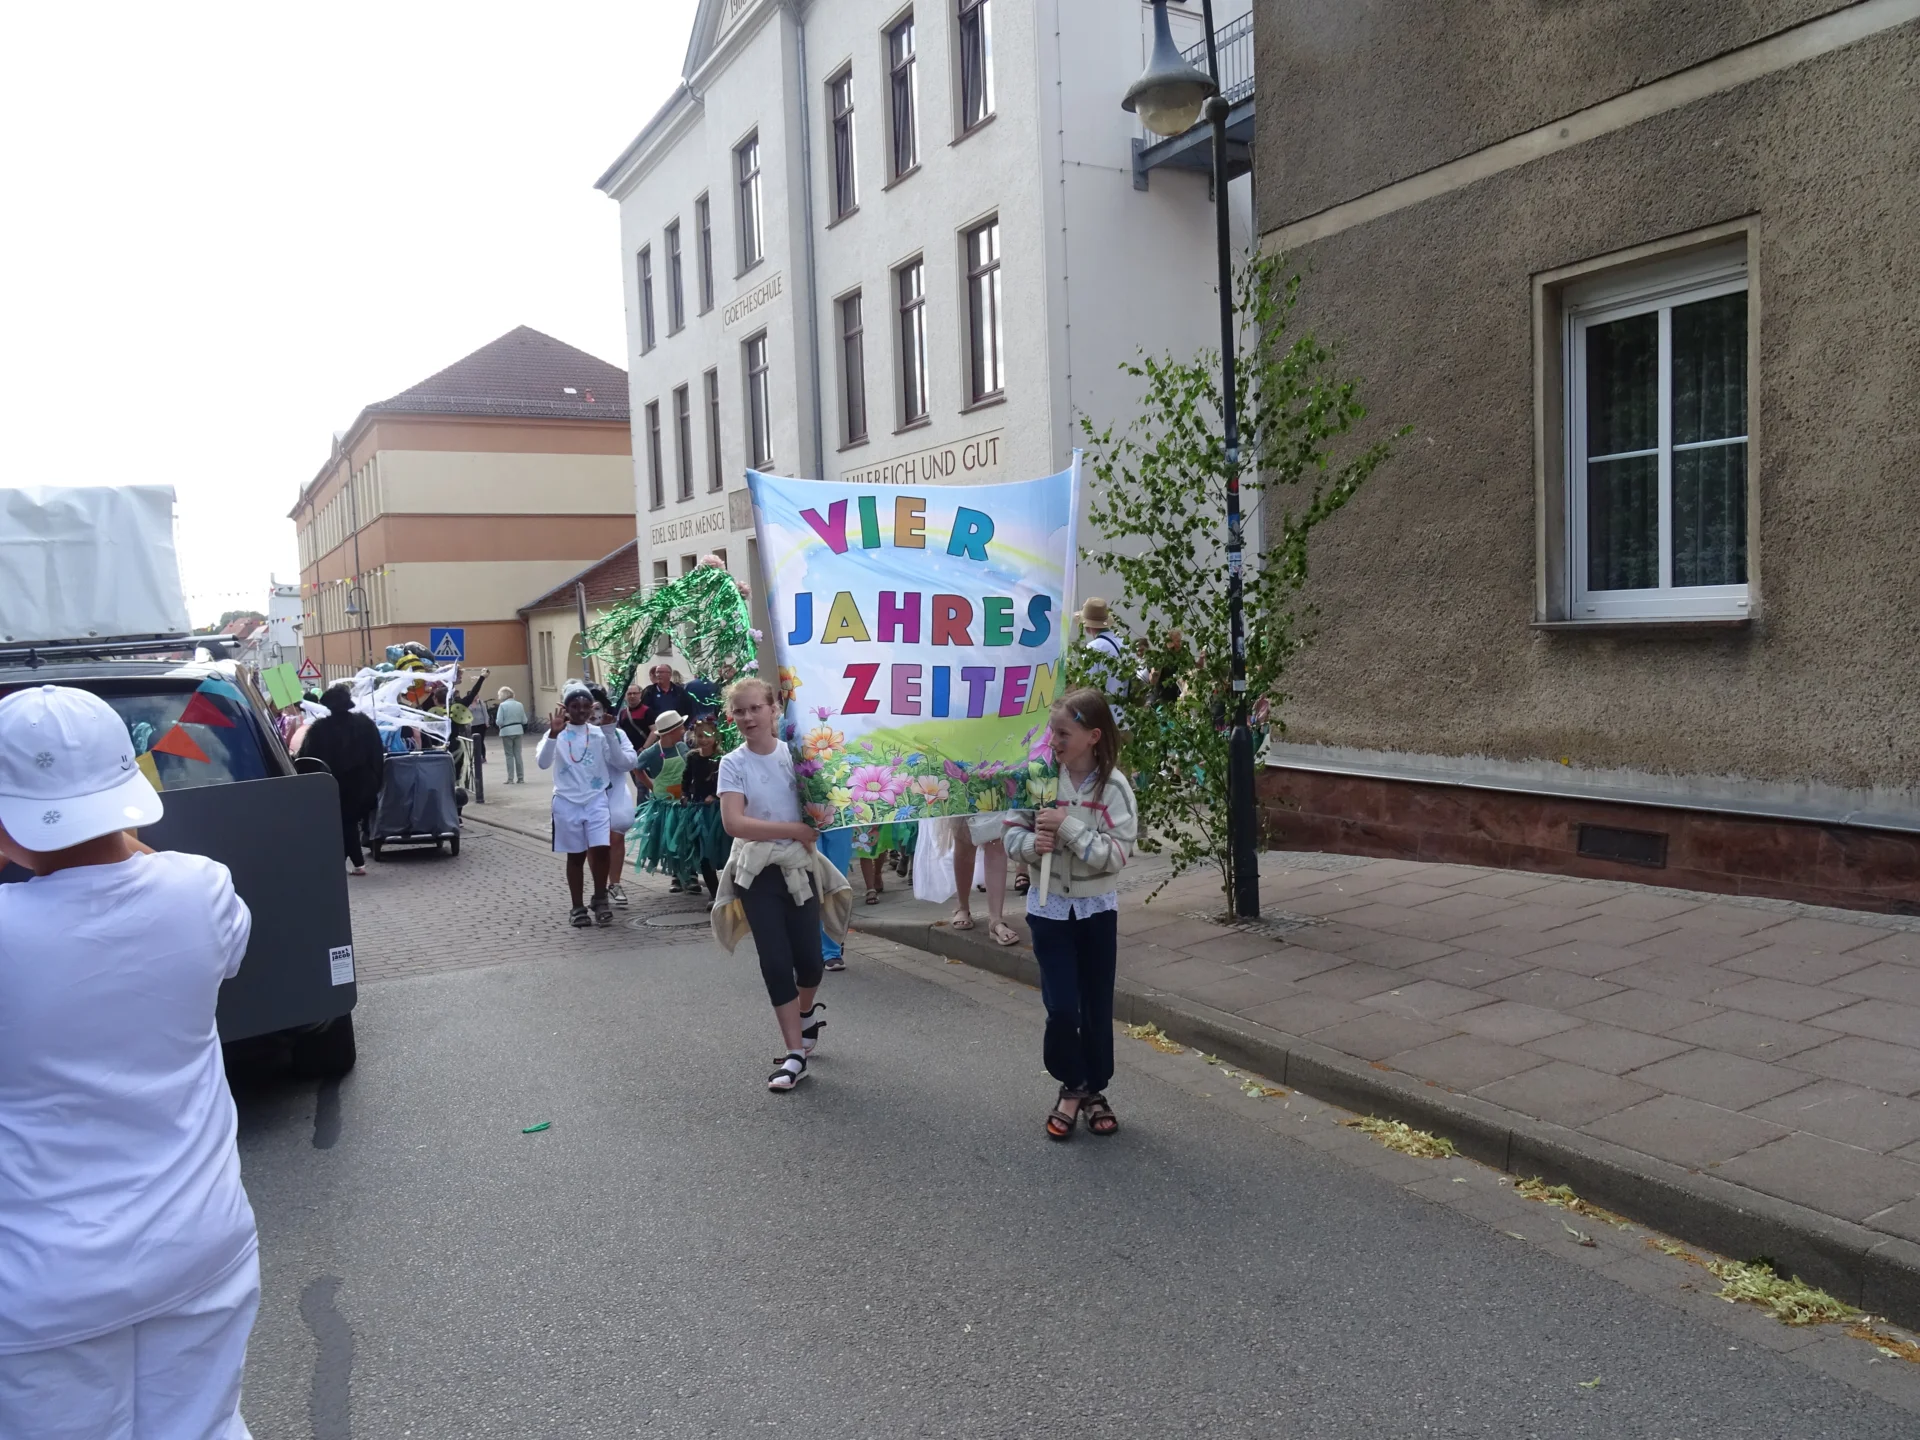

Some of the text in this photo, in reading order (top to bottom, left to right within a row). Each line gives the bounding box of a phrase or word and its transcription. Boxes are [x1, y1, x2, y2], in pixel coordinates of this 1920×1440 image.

[724, 276, 782, 326] GOETHESCHULE
[921, 450, 956, 481] UND
[962, 437, 1000, 471] GUT
[652, 527, 666, 544] EDEL
[668, 524, 677, 541] SEI
[680, 520, 694, 538] DER
[799, 495, 995, 561] VIER
[788, 590, 1052, 647] JAHRES
[840, 657, 1060, 718] ZEITEN
